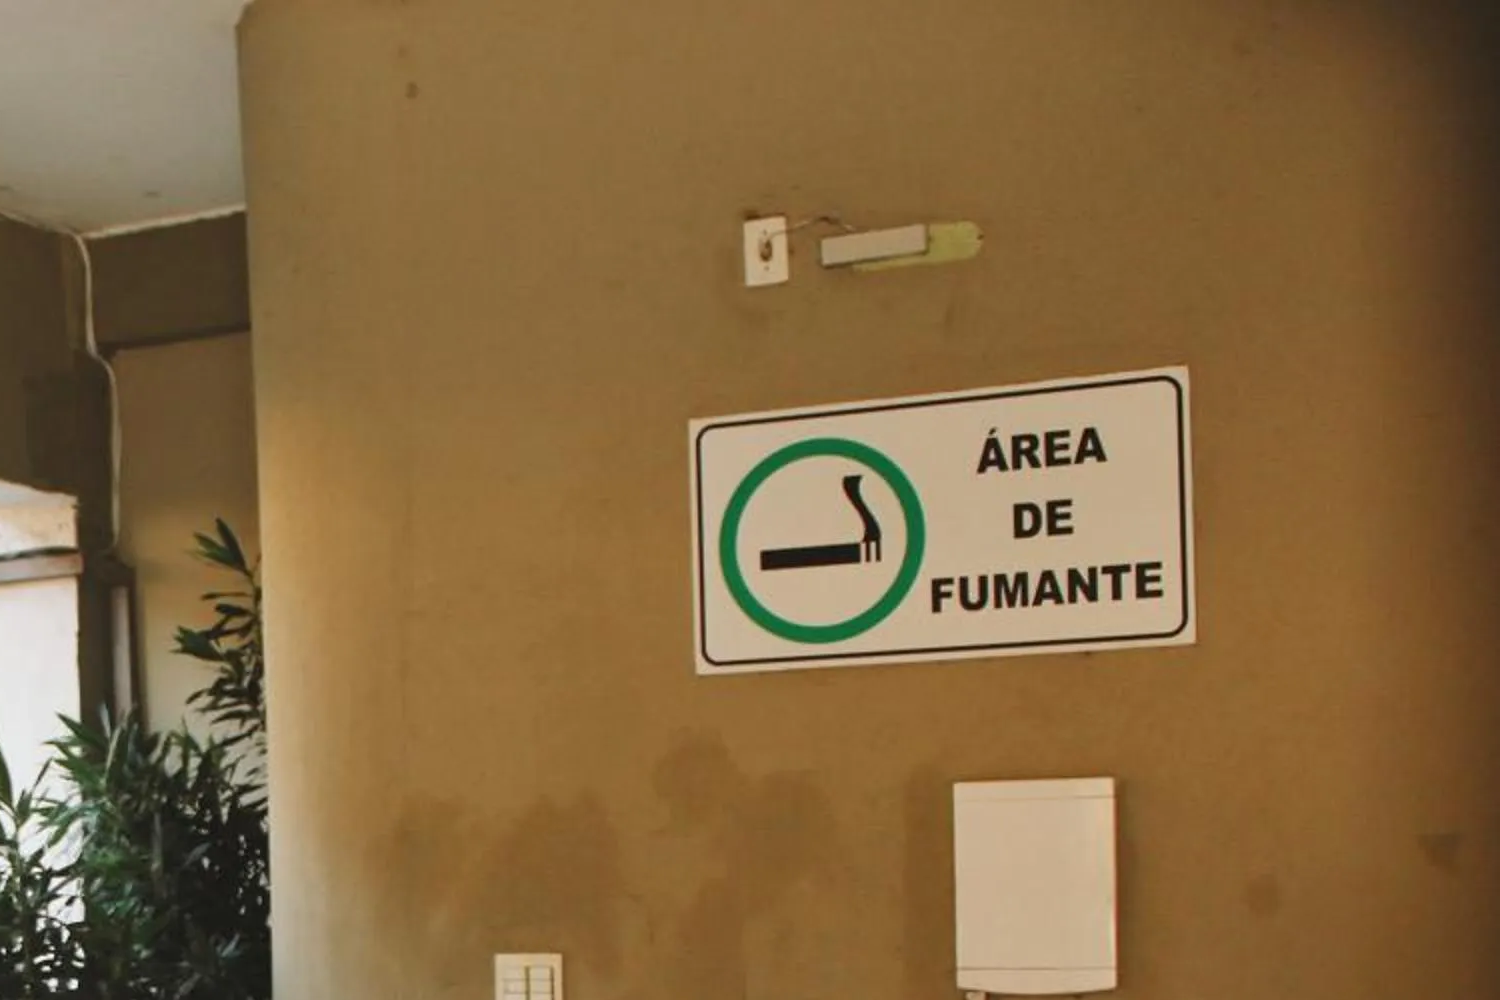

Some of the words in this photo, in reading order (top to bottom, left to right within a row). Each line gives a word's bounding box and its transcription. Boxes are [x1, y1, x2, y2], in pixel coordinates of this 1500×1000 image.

[977, 427, 1107, 474] ÁREA
[1013, 499, 1074, 539] DE
[931, 561, 1164, 614] FUMANTE
